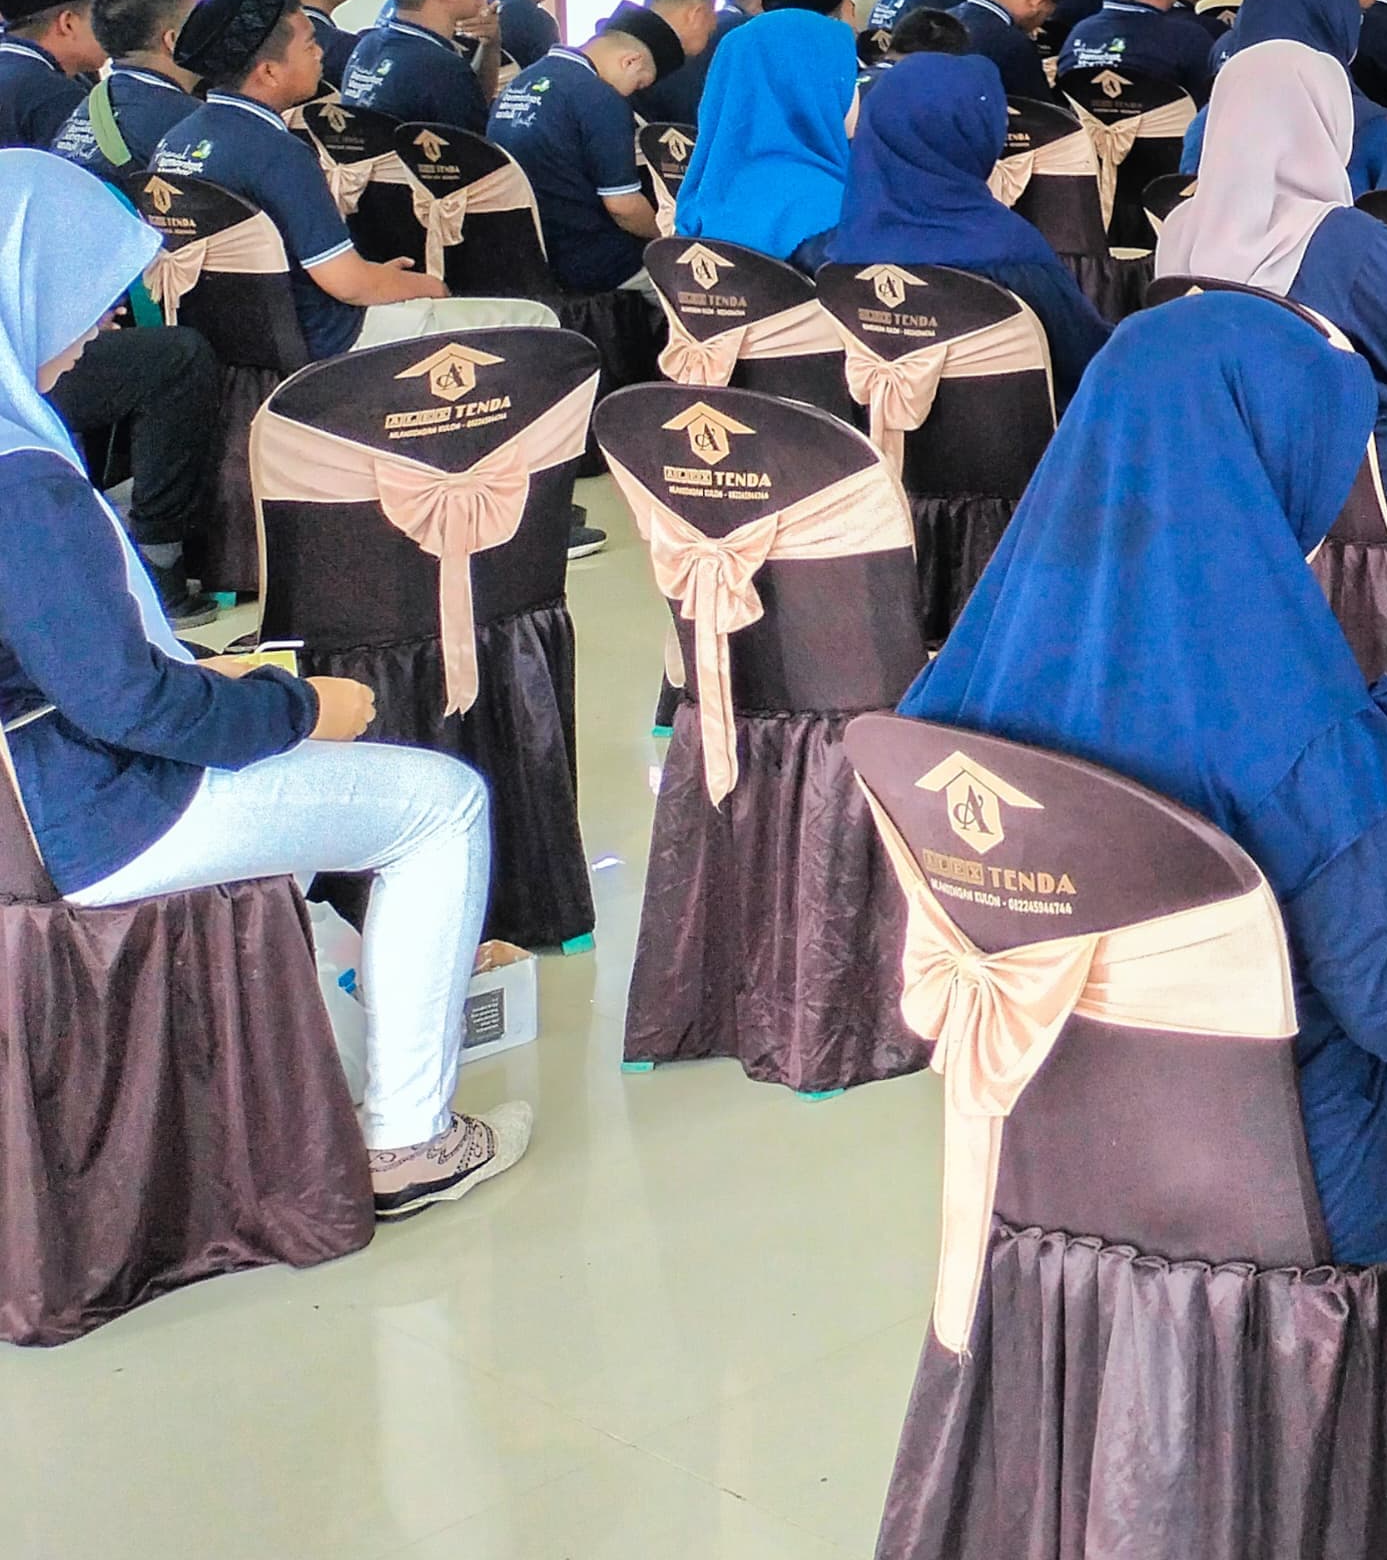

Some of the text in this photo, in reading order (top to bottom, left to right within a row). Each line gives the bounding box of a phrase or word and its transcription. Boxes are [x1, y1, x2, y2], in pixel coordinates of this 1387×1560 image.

[706, 295, 748, 308] TENDA
[893, 312, 939, 329] TENDA
[455, 395, 513, 419] TENDA
[714, 470, 773, 488] TENDA
[987, 866, 1077, 895] TENDA
[974, 890, 1001, 908] KULON
